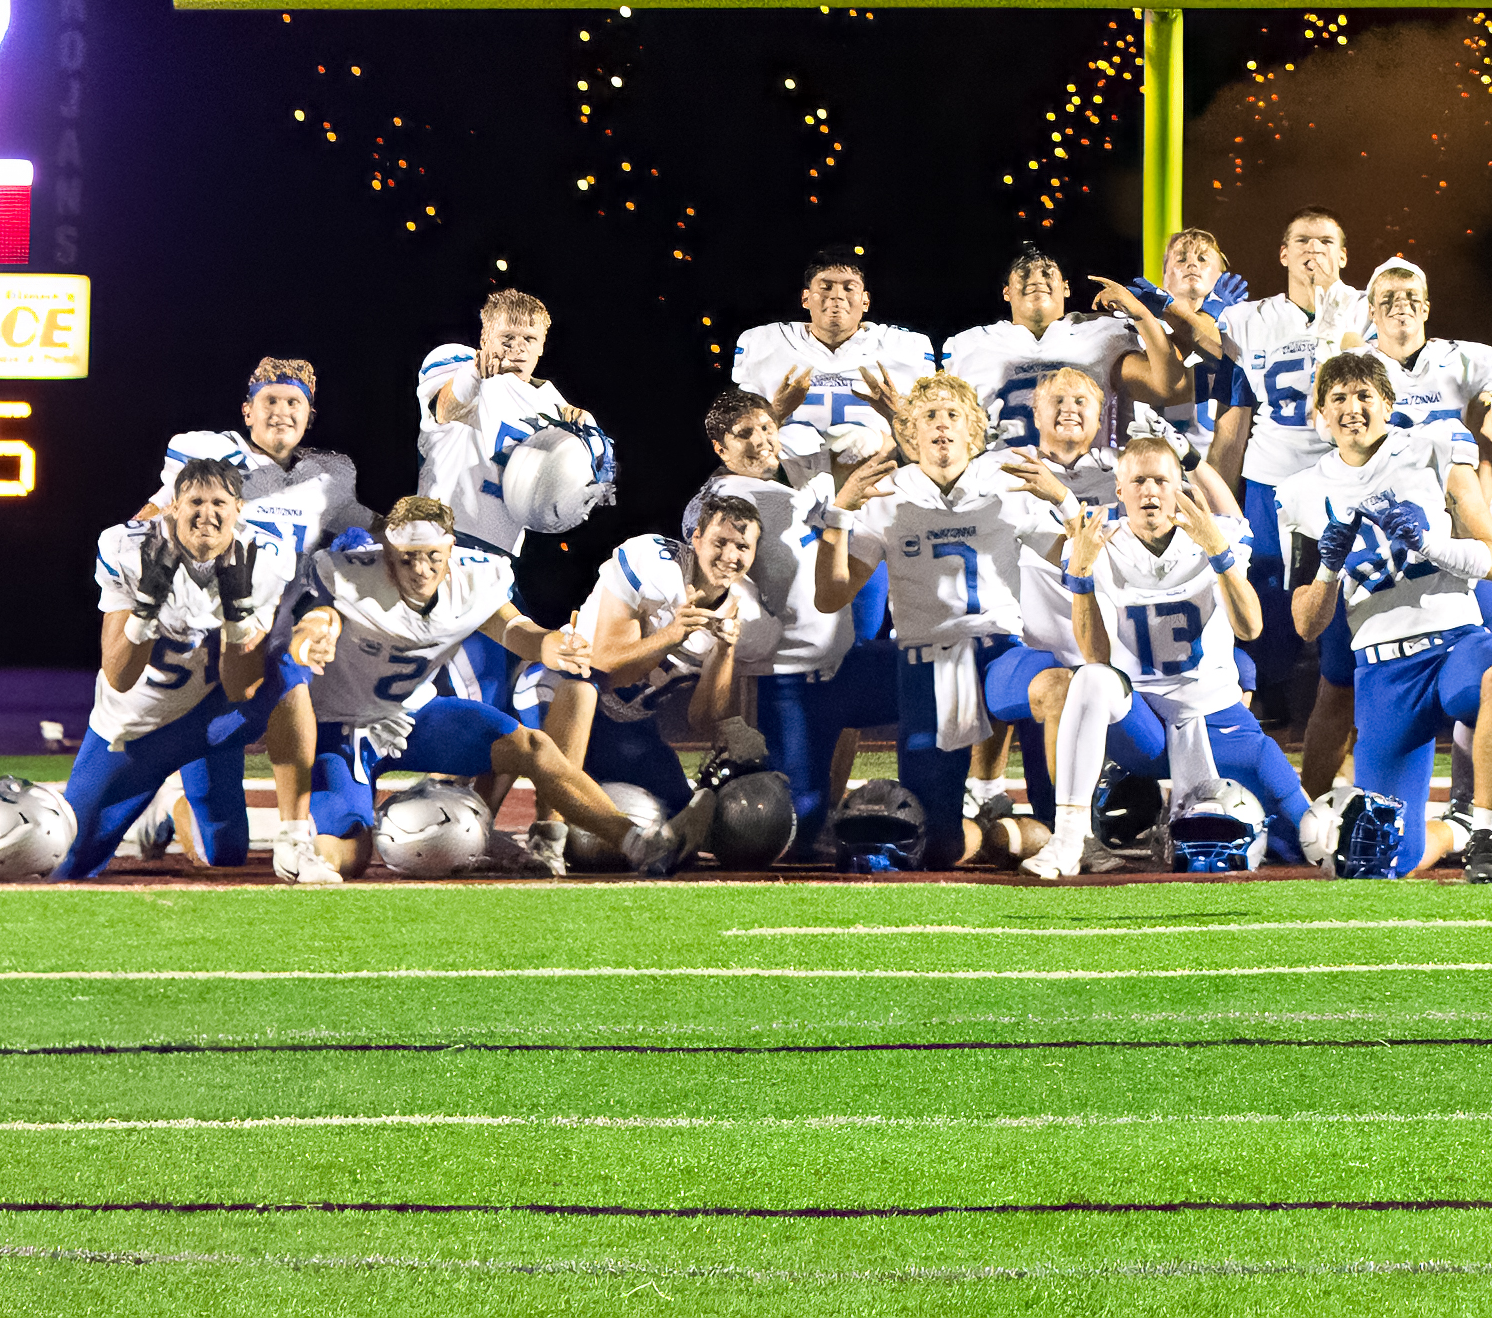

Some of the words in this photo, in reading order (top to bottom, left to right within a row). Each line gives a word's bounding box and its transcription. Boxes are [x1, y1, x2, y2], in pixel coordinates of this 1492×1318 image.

[931, 541, 981, 616] 7
[1125, 600, 1205, 677] 13
[373, 654, 428, 702] 2
